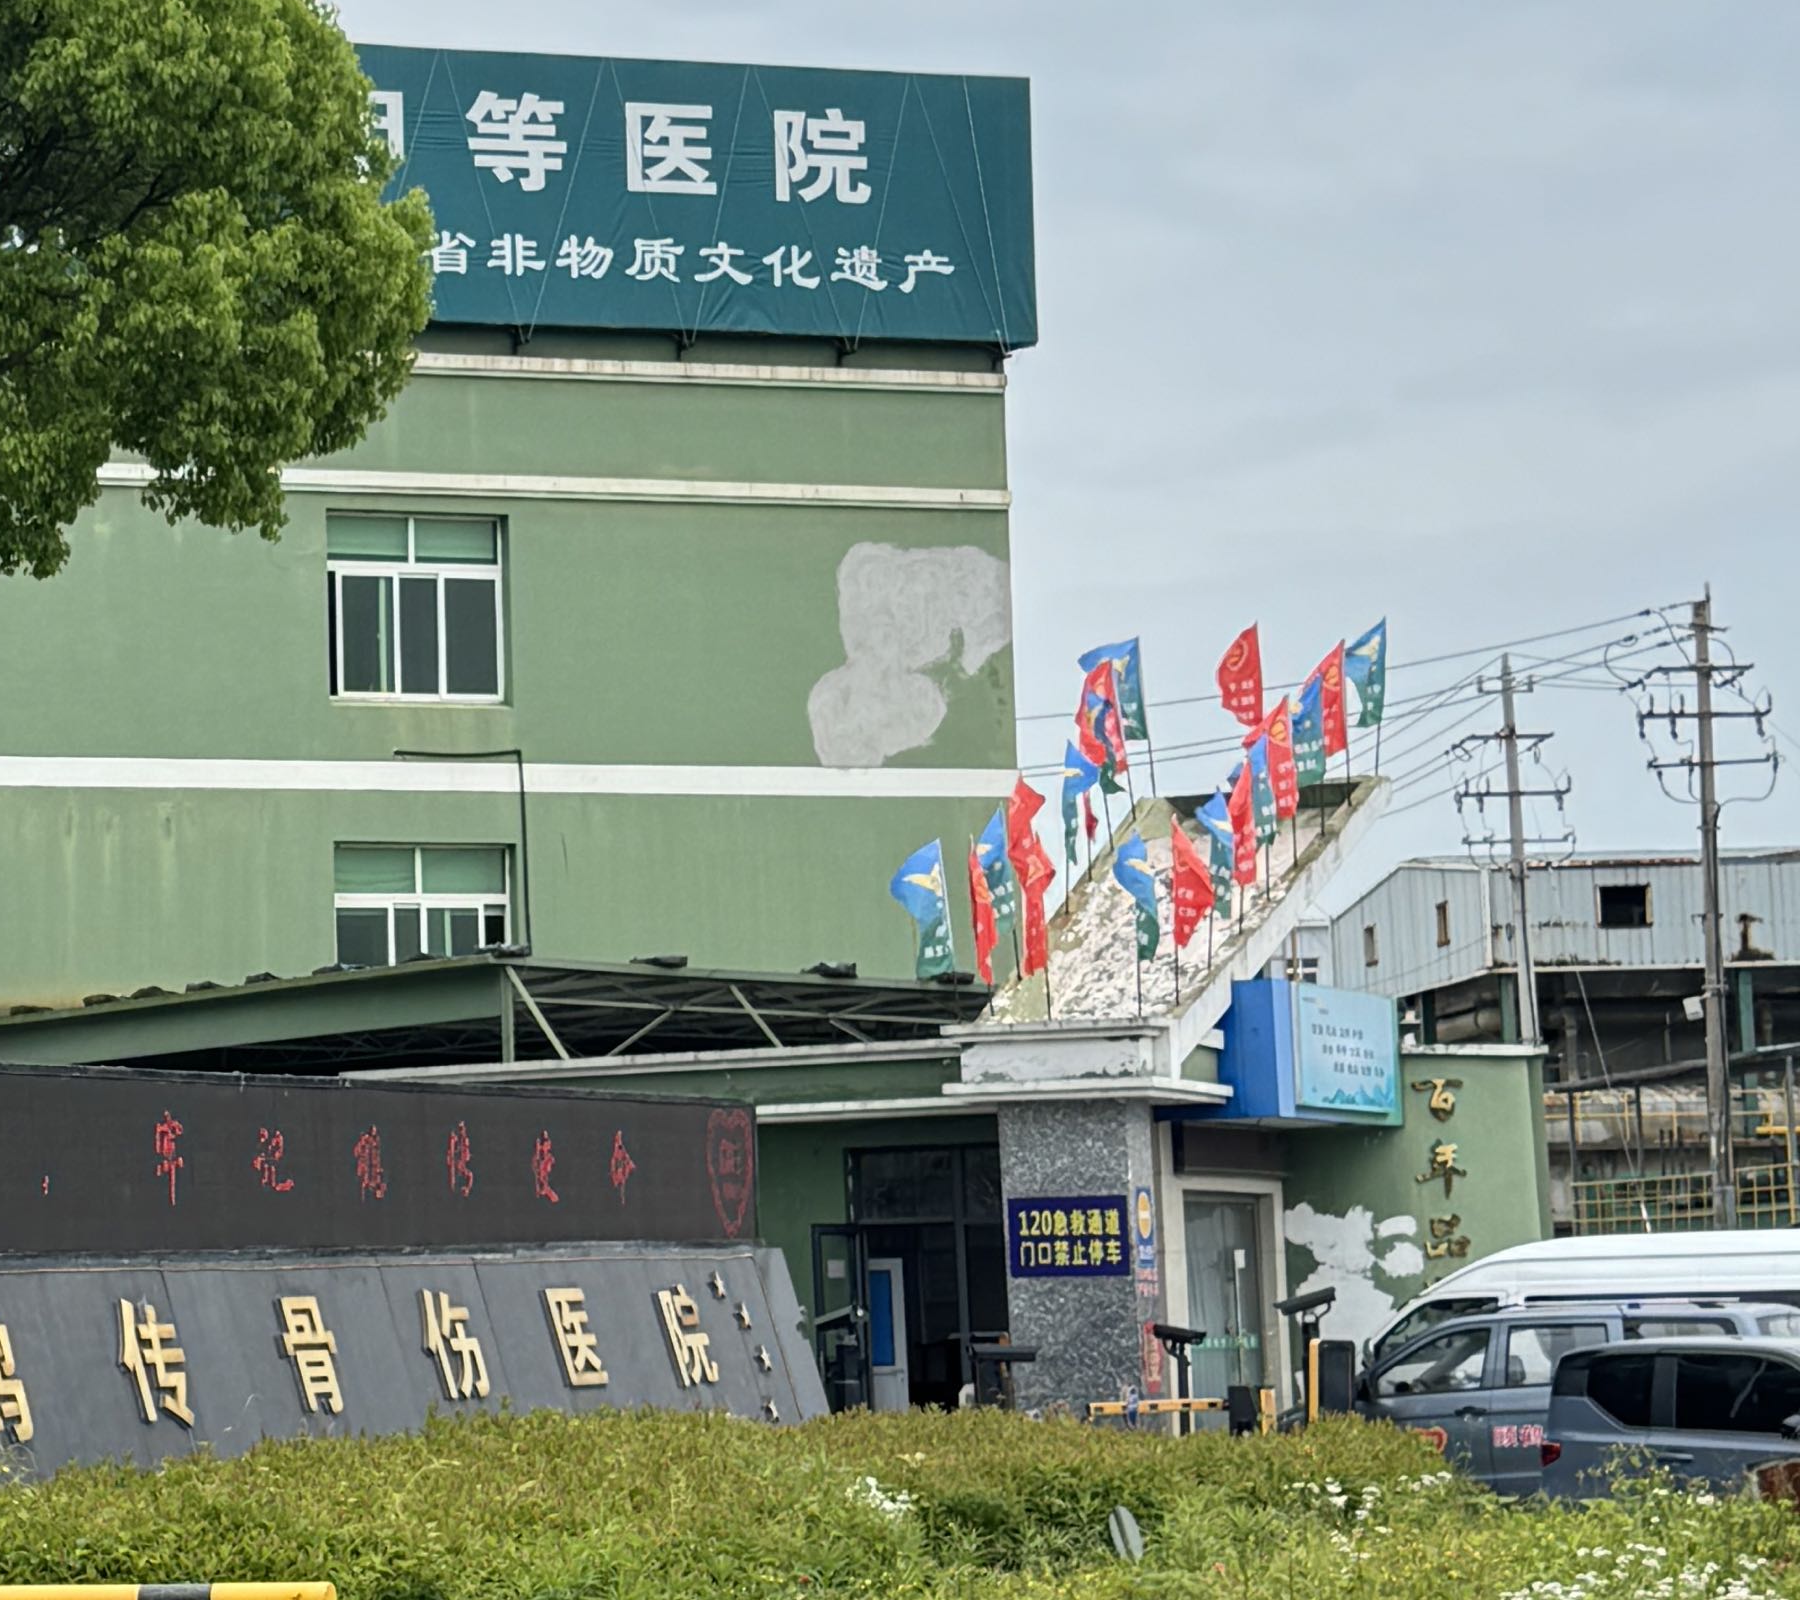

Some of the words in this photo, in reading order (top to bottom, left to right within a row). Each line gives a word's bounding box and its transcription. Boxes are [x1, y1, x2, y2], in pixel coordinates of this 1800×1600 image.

[422, 231, 955, 294] 省非物质文化遗产
[1411, 1077, 1472, 1289] 百年品
[1017, 1207, 1121, 1237] 120急救通道
[1019, 1238, 1122, 1267] 门口禁止停车
